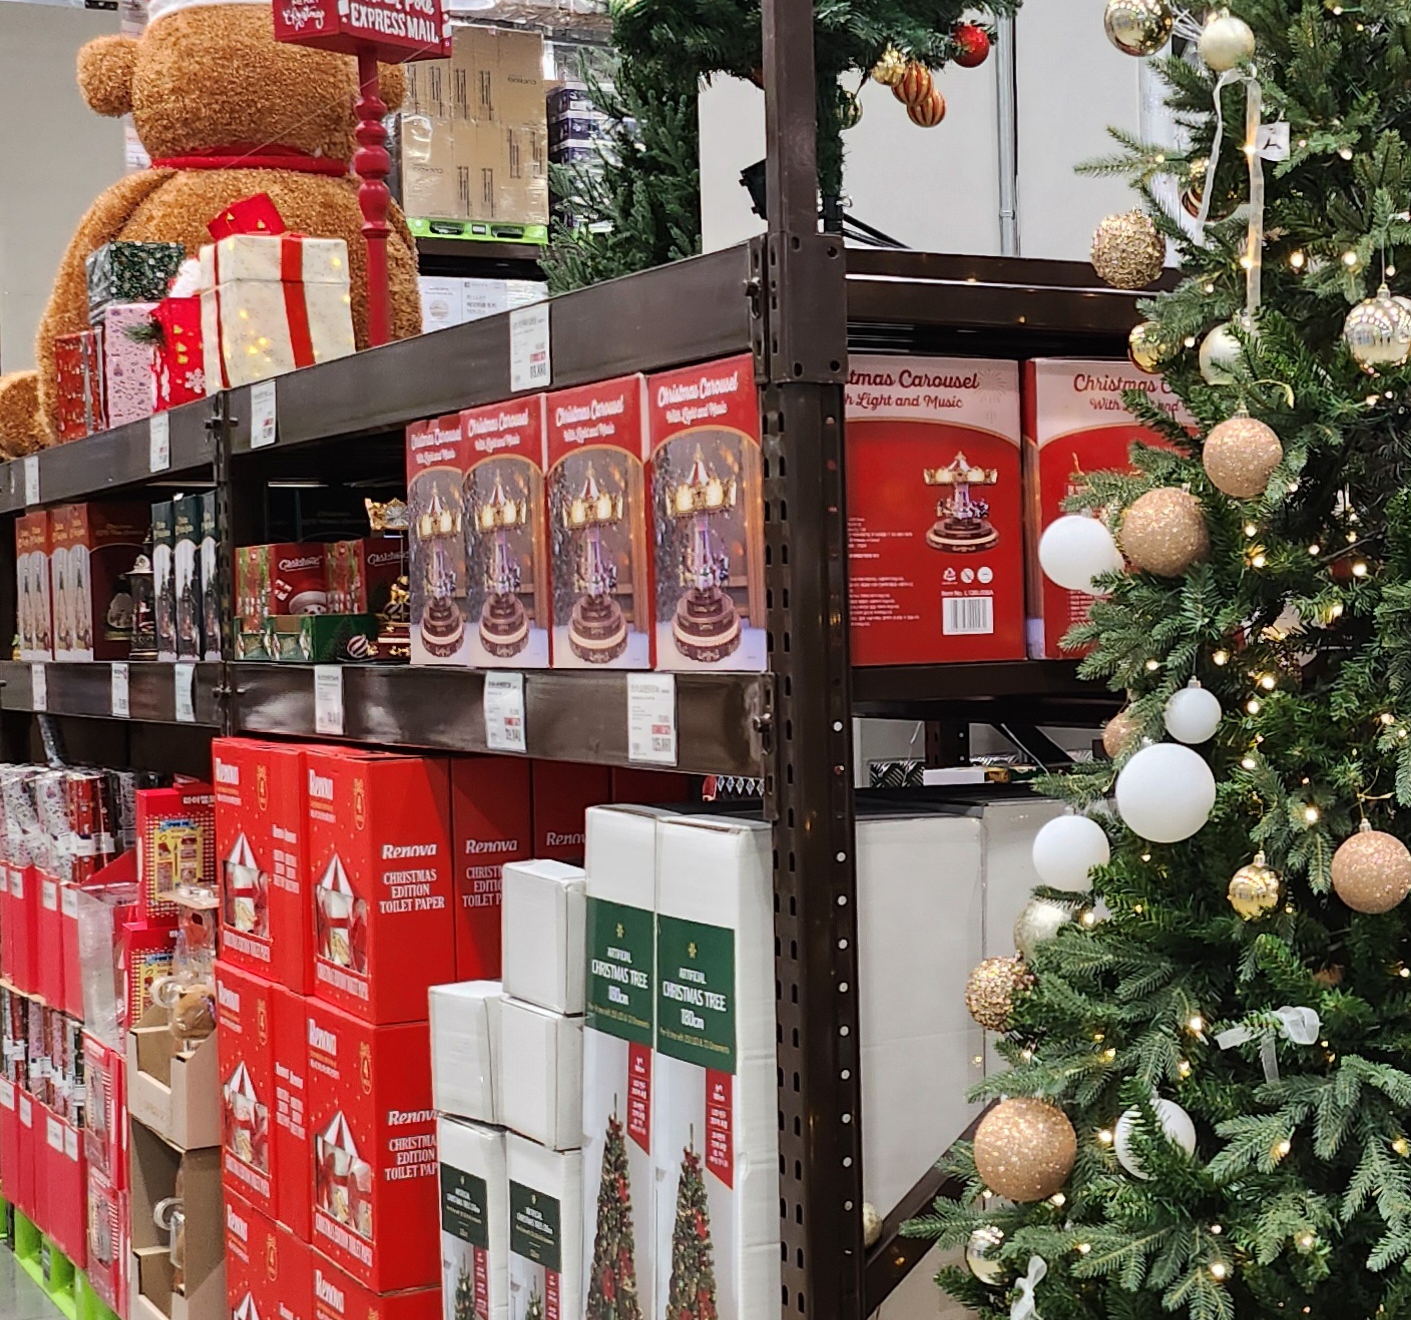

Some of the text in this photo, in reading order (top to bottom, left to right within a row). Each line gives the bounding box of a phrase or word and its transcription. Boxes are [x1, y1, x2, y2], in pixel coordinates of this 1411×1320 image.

[351, 3, 439, 43] EXPRESS MAIL
[899, 370, 979, 389] Carousel
[1073, 374, 1157, 392] Christmas
[658, 371, 738, 408] Christmas Carousel
[591, 394, 624, 420] Carousel
[856, 392, 892, 411] Light
[895, 395, 920, 407] and
[923, 395, 964, 409] Music
[1089, 397, 1120, 411] With
[465, 840, 517, 854] Renova
[546, 832, 585, 847] Renov
[382, 844, 437, 860] Renova
[383, 869, 437, 885] CHRISTMAS
[466, 866, 502, 880] CHRIST
[391, 884, 431, 898] EDITION
[380, 897, 445, 914] TOILET PAPER
[462, 894, 493, 908] TOILET
[592, 959, 648, 989] CHRISTMAS TREE
[663, 981, 726, 1012] CHRISTMAS TREE
[389, 1134, 437, 1152] CHRISTMA
[397, 1151, 435, 1166] EDITION
[384, 1163, 439, 1181] TOILET PAP
